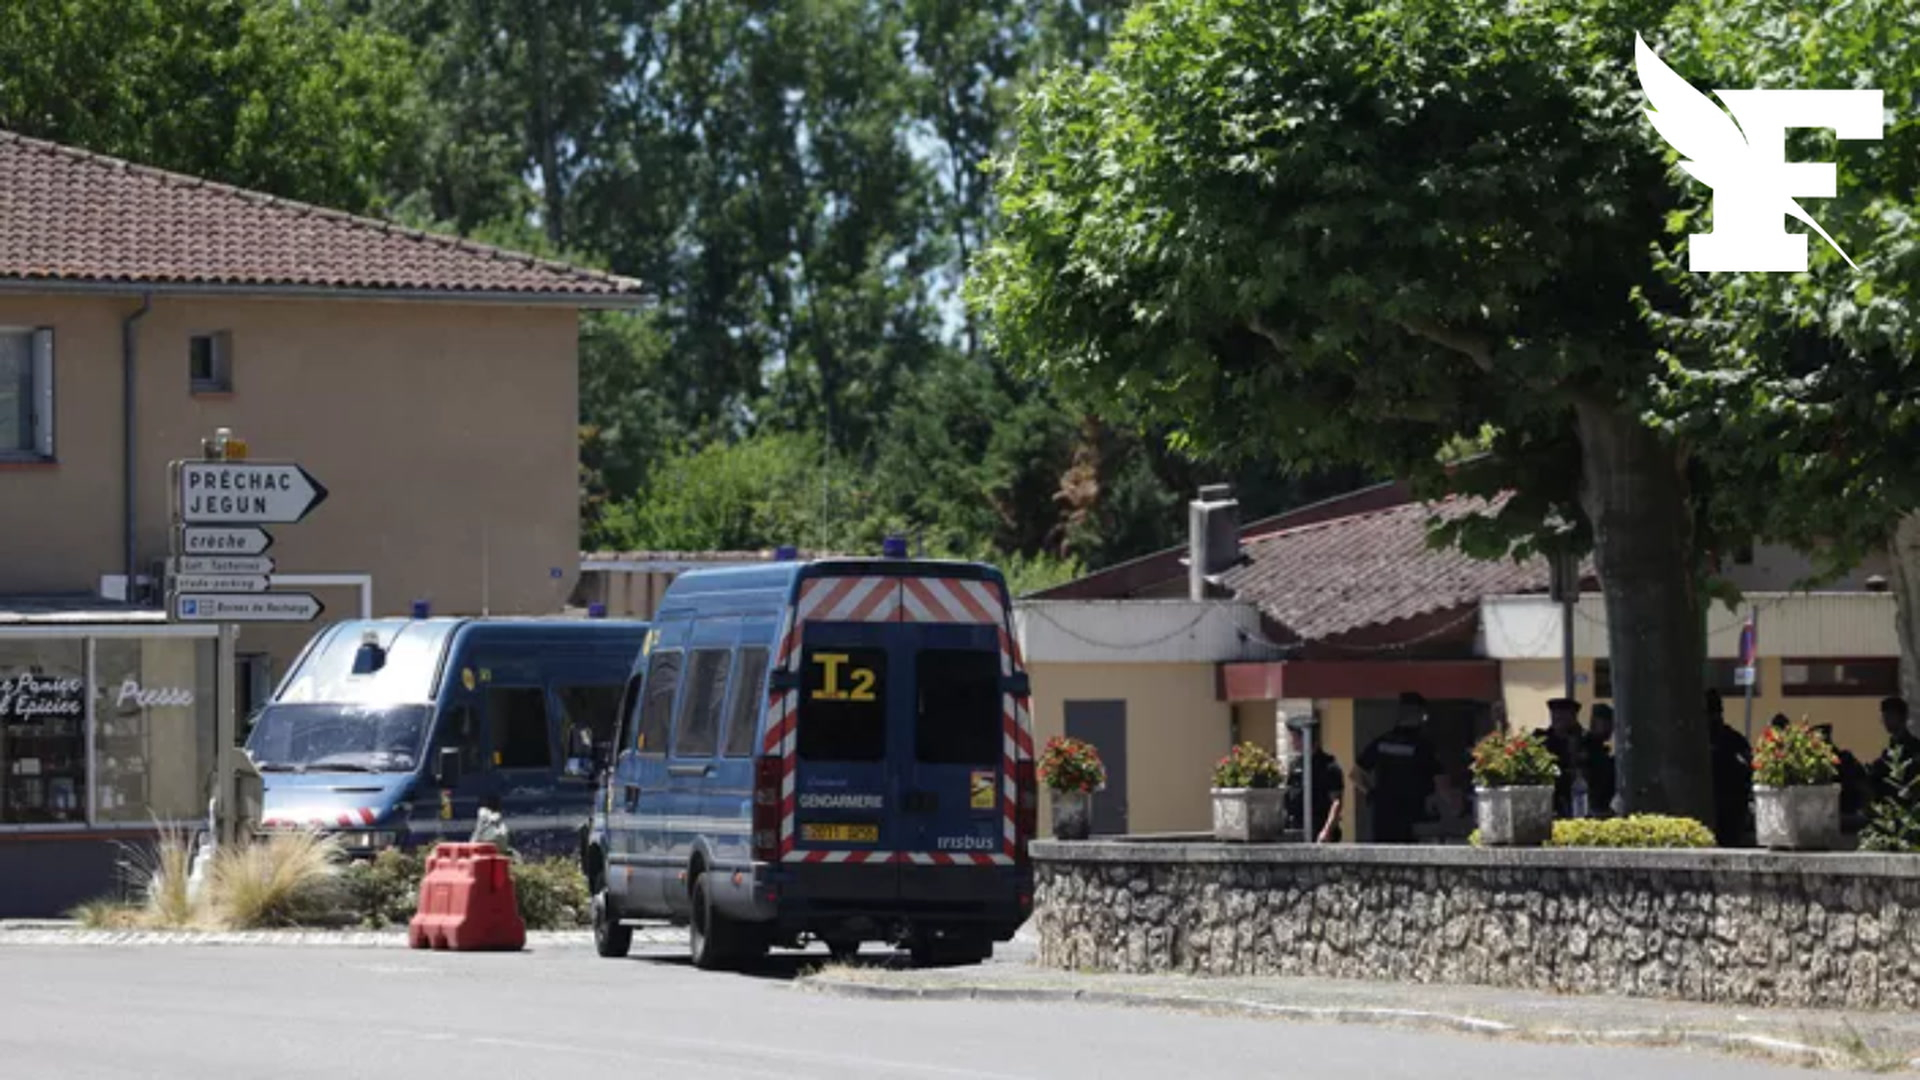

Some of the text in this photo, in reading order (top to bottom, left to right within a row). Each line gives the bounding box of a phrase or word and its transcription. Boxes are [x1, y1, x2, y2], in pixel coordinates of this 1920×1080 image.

[190, 470, 291, 490] PRÉCHAC
[190, 497, 266, 514] JEGUN
[190, 534, 246, 548] crèche
[12, 672, 82, 697] Panier
[116, 680, 194, 707] Presse
[800, 793, 883, 808] GENDARMERIE
[937, 834, 994, 850] irisbus
